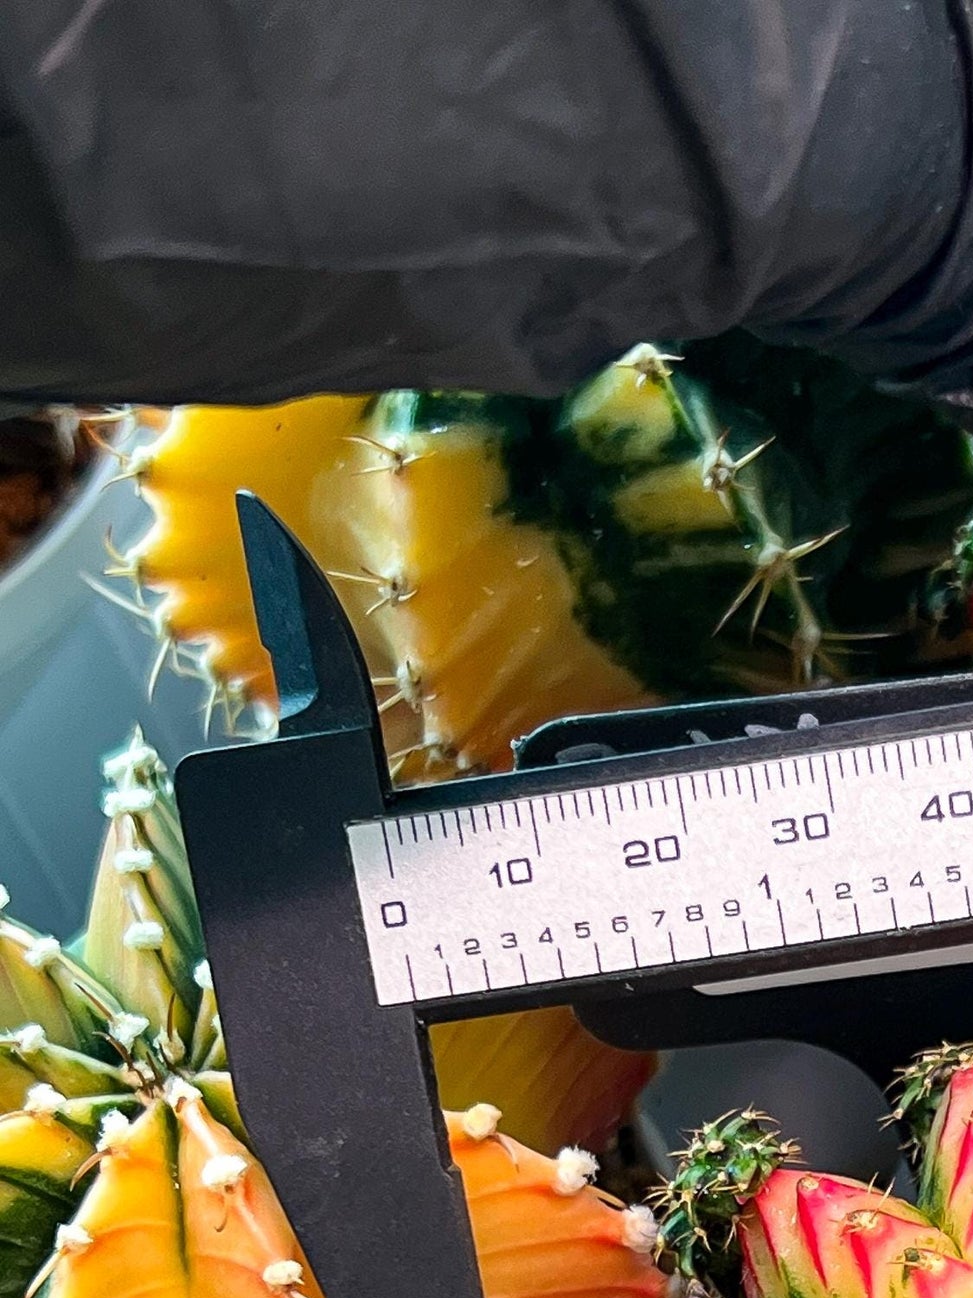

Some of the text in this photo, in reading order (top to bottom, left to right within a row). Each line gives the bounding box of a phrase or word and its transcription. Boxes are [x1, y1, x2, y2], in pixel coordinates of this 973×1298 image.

[381, 901, 407, 928] 0
[488, 858, 533, 888] 10
[623, 835, 681, 868] 20
[771, 813, 830, 845] 30
[463, 938, 481, 955] 2
[500, 933, 518, 949] 3
[538, 927, 553, 944] 4
[574, 921, 591, 938] 5
[611, 916, 629, 933] 6
[651, 910, 666, 927] 7
[685, 904, 704, 922] 8
[723, 900, 741, 917] 9
[835, 883, 853, 900] 2
[872, 877, 889, 893] 3
[909, 871, 925, 888] 4
[945, 865, 962, 882] 5
